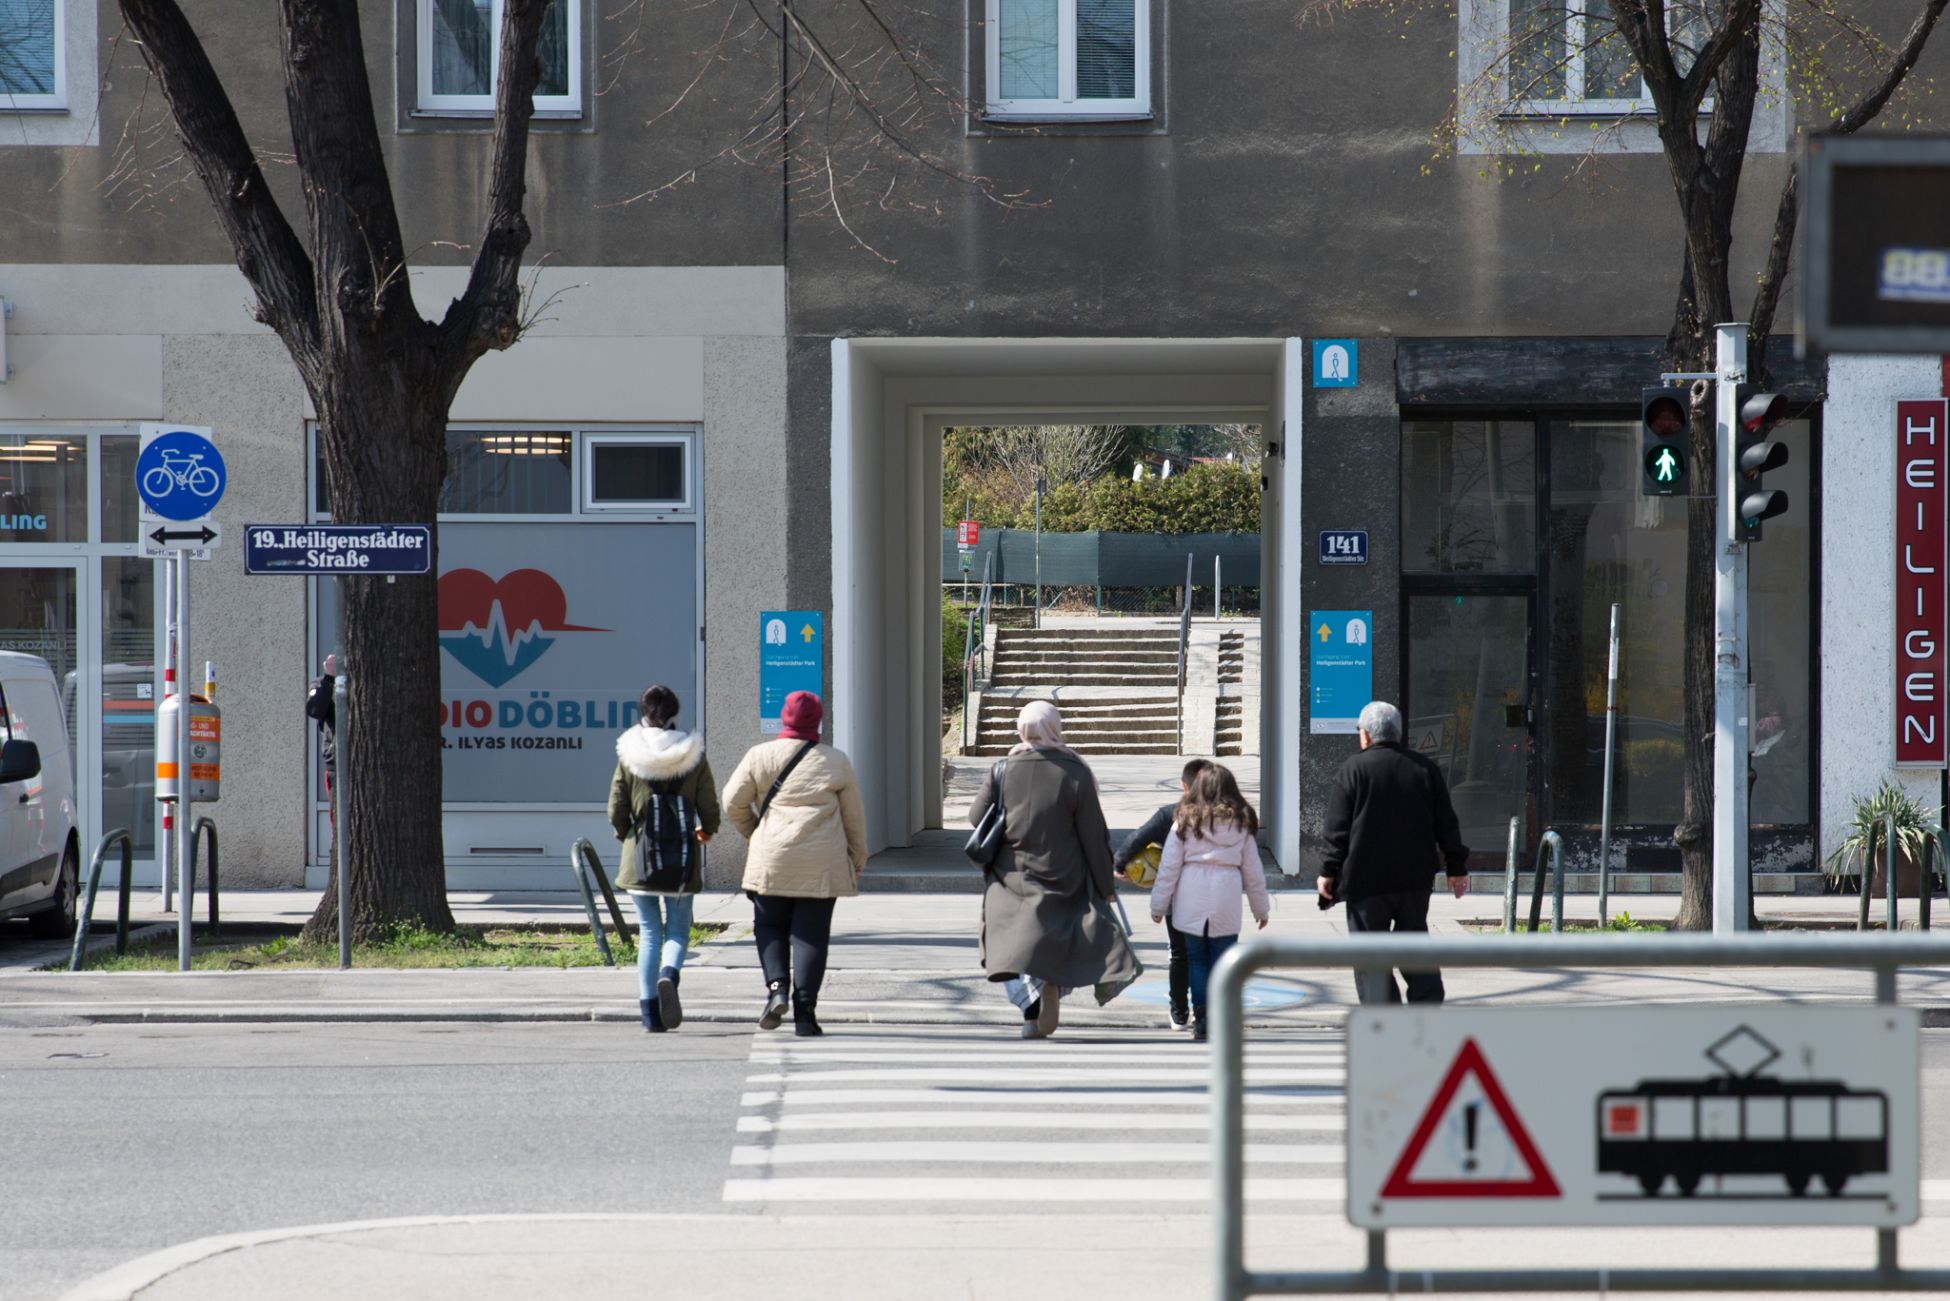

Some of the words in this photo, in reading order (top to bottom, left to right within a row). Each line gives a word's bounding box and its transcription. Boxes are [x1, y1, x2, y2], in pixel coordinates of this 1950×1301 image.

[284, 531, 423, 552] Heiligenstädter
[1326, 535, 1360, 554] 141
[307, 550, 370, 567] Straße
[1904, 416, 1935, 744] HEILIGEN
